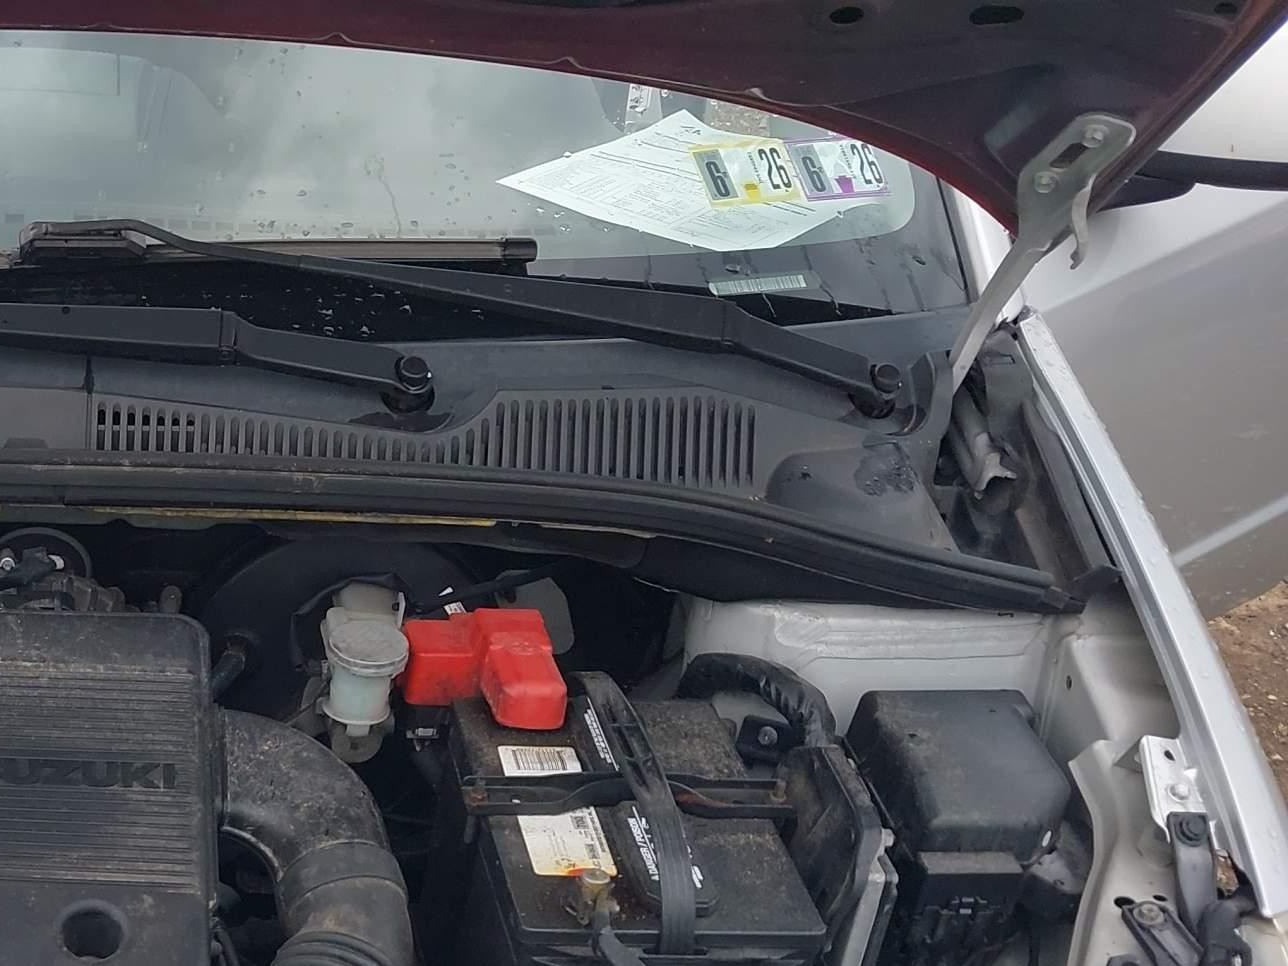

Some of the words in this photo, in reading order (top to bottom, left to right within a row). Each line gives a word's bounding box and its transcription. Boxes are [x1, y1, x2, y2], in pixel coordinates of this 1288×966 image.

[705, 160, 730, 198] 6
[758, 147, 792, 190] 26
[801, 155, 827, 193] 6
[850, 142, 884, 186] 26
